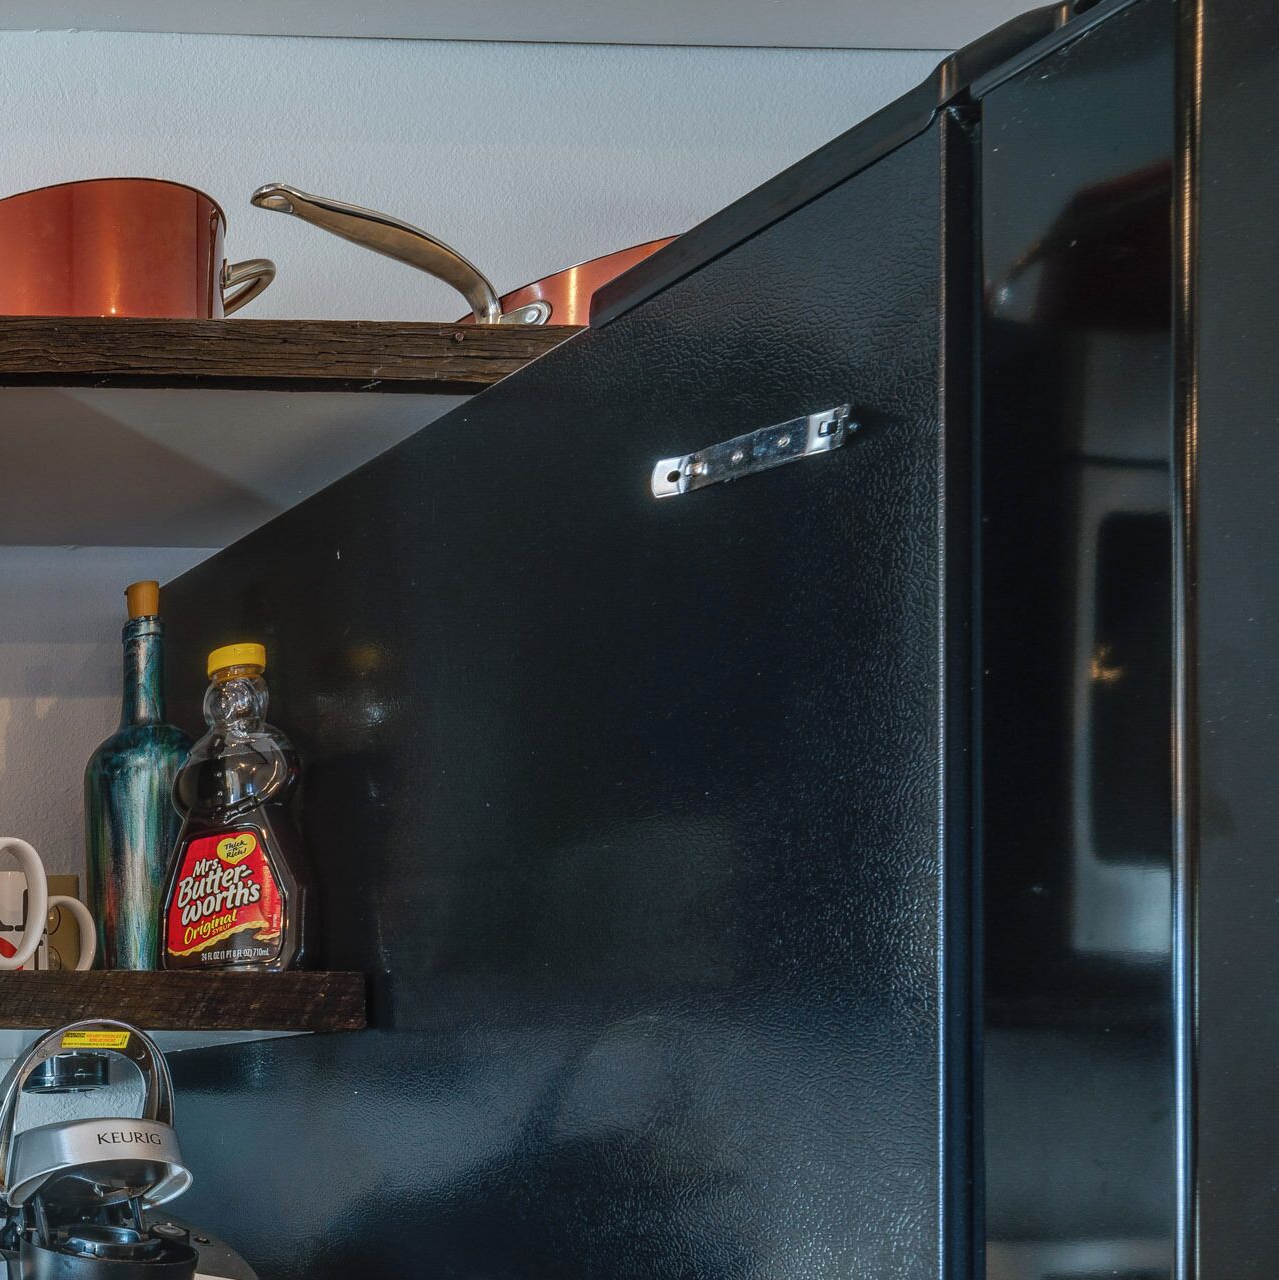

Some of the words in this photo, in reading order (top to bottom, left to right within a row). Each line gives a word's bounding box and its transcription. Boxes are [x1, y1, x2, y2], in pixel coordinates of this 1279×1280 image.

[224, 840, 247, 850] Thick
[226, 848, 247, 858] Rich!
[192, 858, 221, 878] Mrs.
[177, 864, 253, 908] Butter-
[184, 909, 238, 944] Original
[211, 923, 232, 935] SYRUP
[226, 950, 232, 958] PT
[232, 950, 237, 958] 8
[237, 949, 243, 957] FL
[253, 947, 269, 956] 710mL
[97, 1131, 162, 1145] KEURIG
